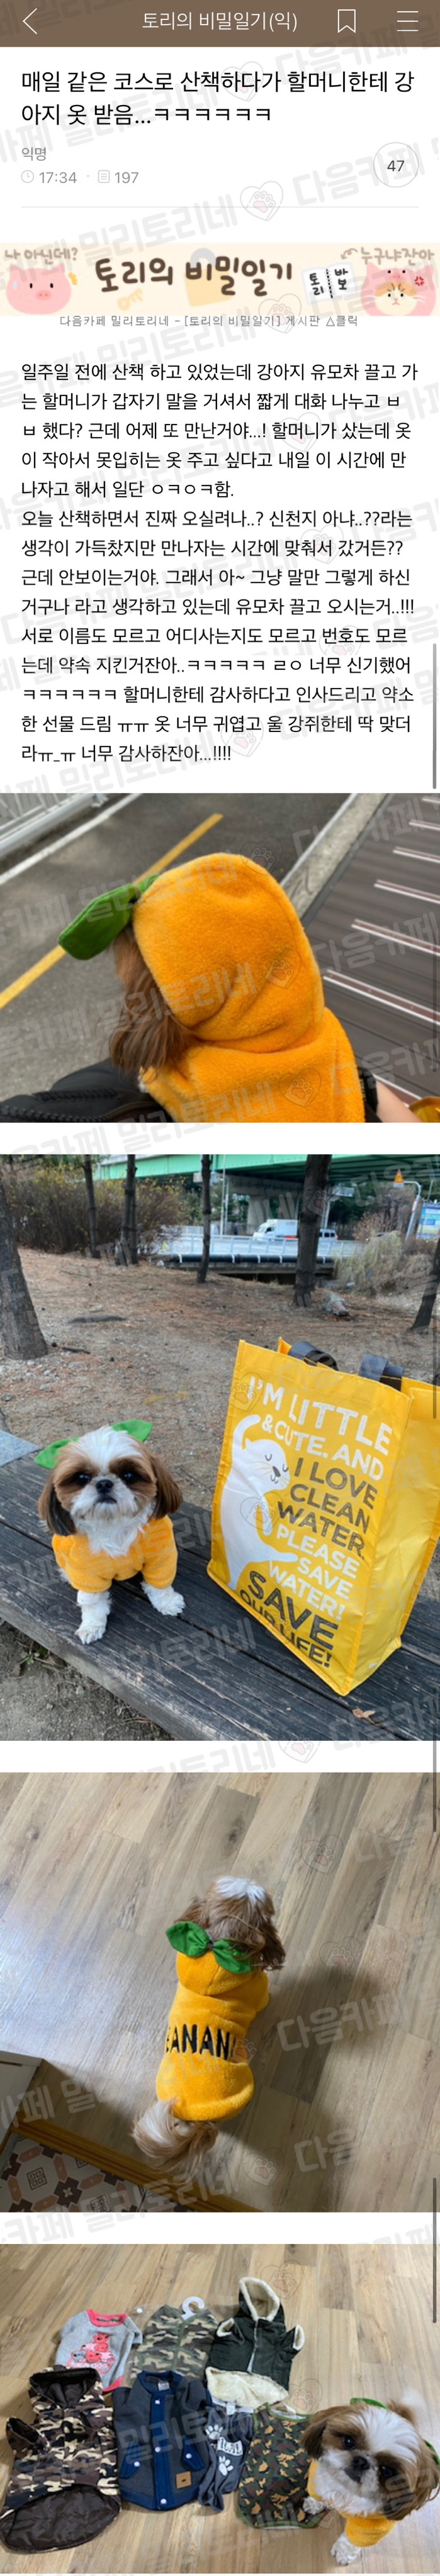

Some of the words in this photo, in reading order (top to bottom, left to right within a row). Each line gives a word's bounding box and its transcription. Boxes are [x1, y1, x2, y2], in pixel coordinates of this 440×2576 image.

[143, 12, 191, 30] 토리의
[200, 12, 296, 31] 비밀일기(익)
[23, 72, 59, 92] 매일
[68, 72, 107, 92] 같은
[114, 73, 173, 89] 코스로
[181, 72, 281, 92] 산책하다가
[288, 72, 386, 92] 할머니한테
[395, 72, 414, 92] 강
[22, 104, 59, 125] 아지
[68, 105, 86, 125] 옷
[22, 147, 45, 160] 익명
[388, 160, 404, 171] 47
[40, 172, 77, 183] 17:34
[115, 172, 138, 183] 197
[5, 248, 20, 260] 나
[24, 247, 78, 265] 아닌데?
[95, 257, 172, 292] 토리의
[186, 255, 292, 297] 비밀일기
[60, 316, 104, 326] 다음카페
[112, 316, 167, 326] 밀리토리네
[185, 316, 222, 326] [토리의
[229, 316, 279, 326] 비밀일기]
[286, 316, 320, 326] 게시판
[22, 364, 68, 380] 일주일
[76, 364, 106, 380] 전에
[113, 364, 143, 380] 산책
[150, 364, 181, 380] 하고
[188, 364, 250, 380] 있었는데
[257, 364, 303, 380] 강아지
[311, 364, 359, 380] 유모차
[365, 365, 396, 380] 끌고
[403, 364, 418, 380] 가
[22, 394, 37, 409] 는
[43, 393, 107, 409] 할머니가
[113, 393, 159, 409] 갑자기
[167, 393, 198, 409] 말을
[204, 393, 250, 409] 거셔서
[257, 393, 288, 409] 짧게
[295, 393, 326, 409] 대화
[332, 393, 380, 409] 나누고
[388, 397, 398, 406] ㅂ
[25, 426, 35, 435] ㅂ
[43, 423, 82, 439] 했다?
[89, 423, 118, 439] 근데
[127, 423, 156, 439] 어제
[164, 424, 178, 437] 또
[272, 423, 336, 439] 할머니가
[342, 423, 388, 439] 샀는데
[396, 423, 410, 439] 옷
[22, 452, 35, 468] 이
[43, 452, 89, 468] 작아서
[97, 452, 160, 468] 못입히는
[167, 452, 181, 468] 옷
[188, 453, 218, 468] 주고
[225, 452, 272, 468] 싶다고
[279, 452, 309, 468] 내일
[317, 452, 330, 468] 이
[337, 452, 384, 468] 시간에
[392, 452, 406, 468] 만
[22, 481, 69, 497] 나자고
[75, 481, 105, 497] 해서
[113, 481, 144, 497] 일단
[152, 481, 233, 497] ㅇㅋㅇㅋ함.
[22, 511, 53, 527] 오늘
[59, 511, 137, 527] 산책하면서
[146, 511, 177, 527] 진짜
[270, 511, 315, 527] 신천지
[22, 540, 68, 557] 생각이
[76, 540, 155, 557] 가득찼지만
[162, 540, 225, 556] 만나자는
[232, 540, 278, 556] 시간에
[286, 540, 331, 557] 맞춰서
[339, 540, 402, 557] 갔거든??
[22, 569, 52, 586] 근데
[59, 569, 158, 586] 안보이는거야.
[166, 569, 212, 586] 그래서
[220, 569, 244, 586] 아~
[251, 569, 282, 586] 그냥
[288, 569, 319, 586] 말만
[325, 569, 372, 586] 그렇게
[379, 569, 409, 586] 하신
[22, 599, 69, 615] 거구나
[76, 598, 106, 614] 라고
[113, 598, 176, 615] 생각하고
[183, 598, 229, 615] 있는데
[236, 599, 284, 615] 유모차
[290, 599, 321, 614] 끌고
[22, 628, 53, 644] 서로
[60, 628, 106, 644] 이름도
[113, 629, 160, 642] 모르고
[167, 628, 262, 644] 어디사는지도
[269, 629, 316, 642] 모르고
[323, 628, 369, 643] 번호도
[376, 629, 407, 642] 모르
[22, 657, 52, 674] 는데
[59, 657, 90, 674] 약속
[274, 661, 301, 670] ㄹㅇ
[311, 657, 341, 674] 너무
[347, 657, 409, 674] 신기했어
[124, 686, 203, 702] 할머니한테
[210, 686, 290, 702] 감사하다고
[297, 686, 376, 702] 인사드리고
[383, 686, 414, 702] 약소
[22, 716, 37, 731] 한
[43, 716, 74, 732] 선물
[81, 716, 110, 732] 드림
[118, 723, 149, 732] ㅠㅠ
[155, 716, 170, 732] 옷
[177, 716, 207, 732] 너무
[213, 716, 261, 732] 귀엽고
[268, 716, 282, 732] 울
[289, 716, 351, 732] 강쥐한테
[359, 716, 373, 732] 딱
[380, 716, 409, 732] 맞더
[82, 745, 113, 762] 너무
[247, 1376, 284, 1411] I'M
[288, 1394, 392, 1455] LITTLE
[332, 1444, 383, 1480] AND
[295, 1457, 303, 1477] I
[310, 1462, 378, 1509] LOVE
[290, 1484, 370, 1534] CLEAN
[276, 1524, 359, 1579] PLEASE
[297, 1558, 353, 1600] SAVE
[269, 1560, 346, 1620] WATER!
[248, 1570, 339, 1650] SAVE
[166, 2024, 236, 2060] ANAN
